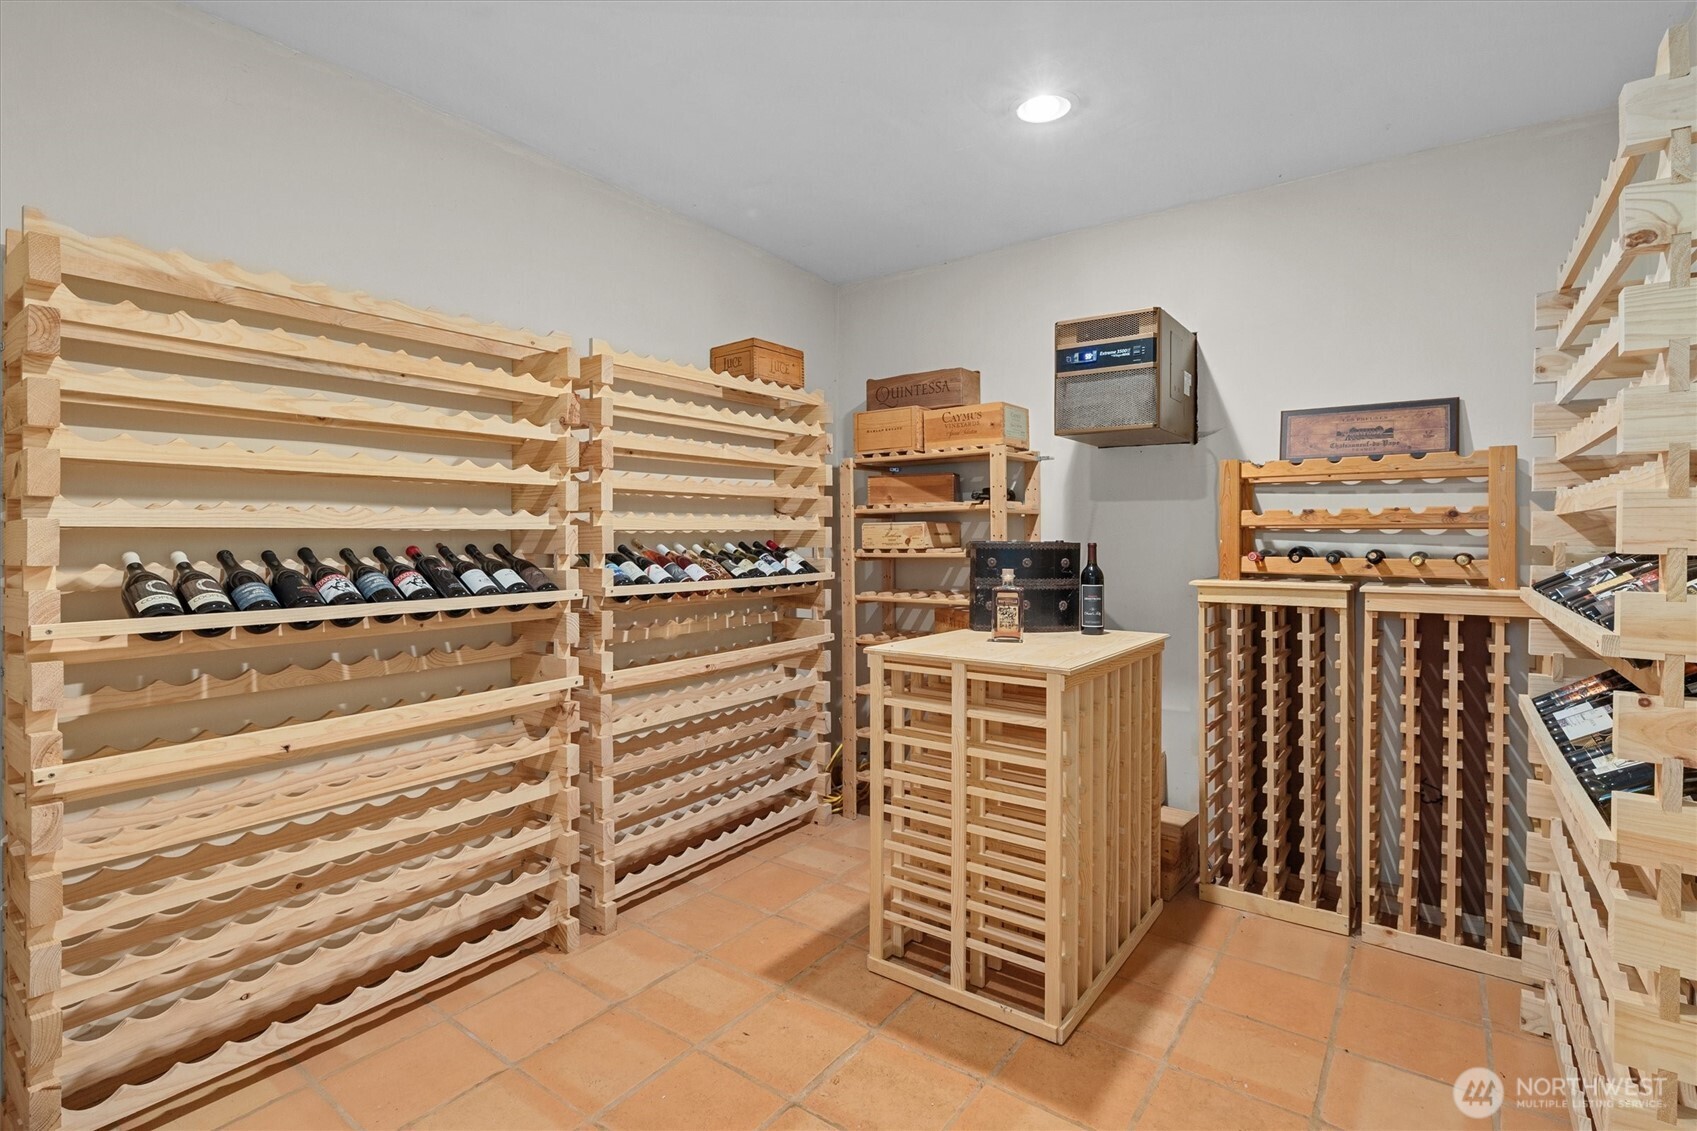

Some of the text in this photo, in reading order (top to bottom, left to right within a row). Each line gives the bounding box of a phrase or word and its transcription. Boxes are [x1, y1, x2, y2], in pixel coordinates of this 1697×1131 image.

[769, 358, 790, 375] LUCE
[875, 380, 951, 408] QUINTESSA
[942, 411, 982, 424] CAYMUS
[944, 420, 981, 429] VINEYARDS
